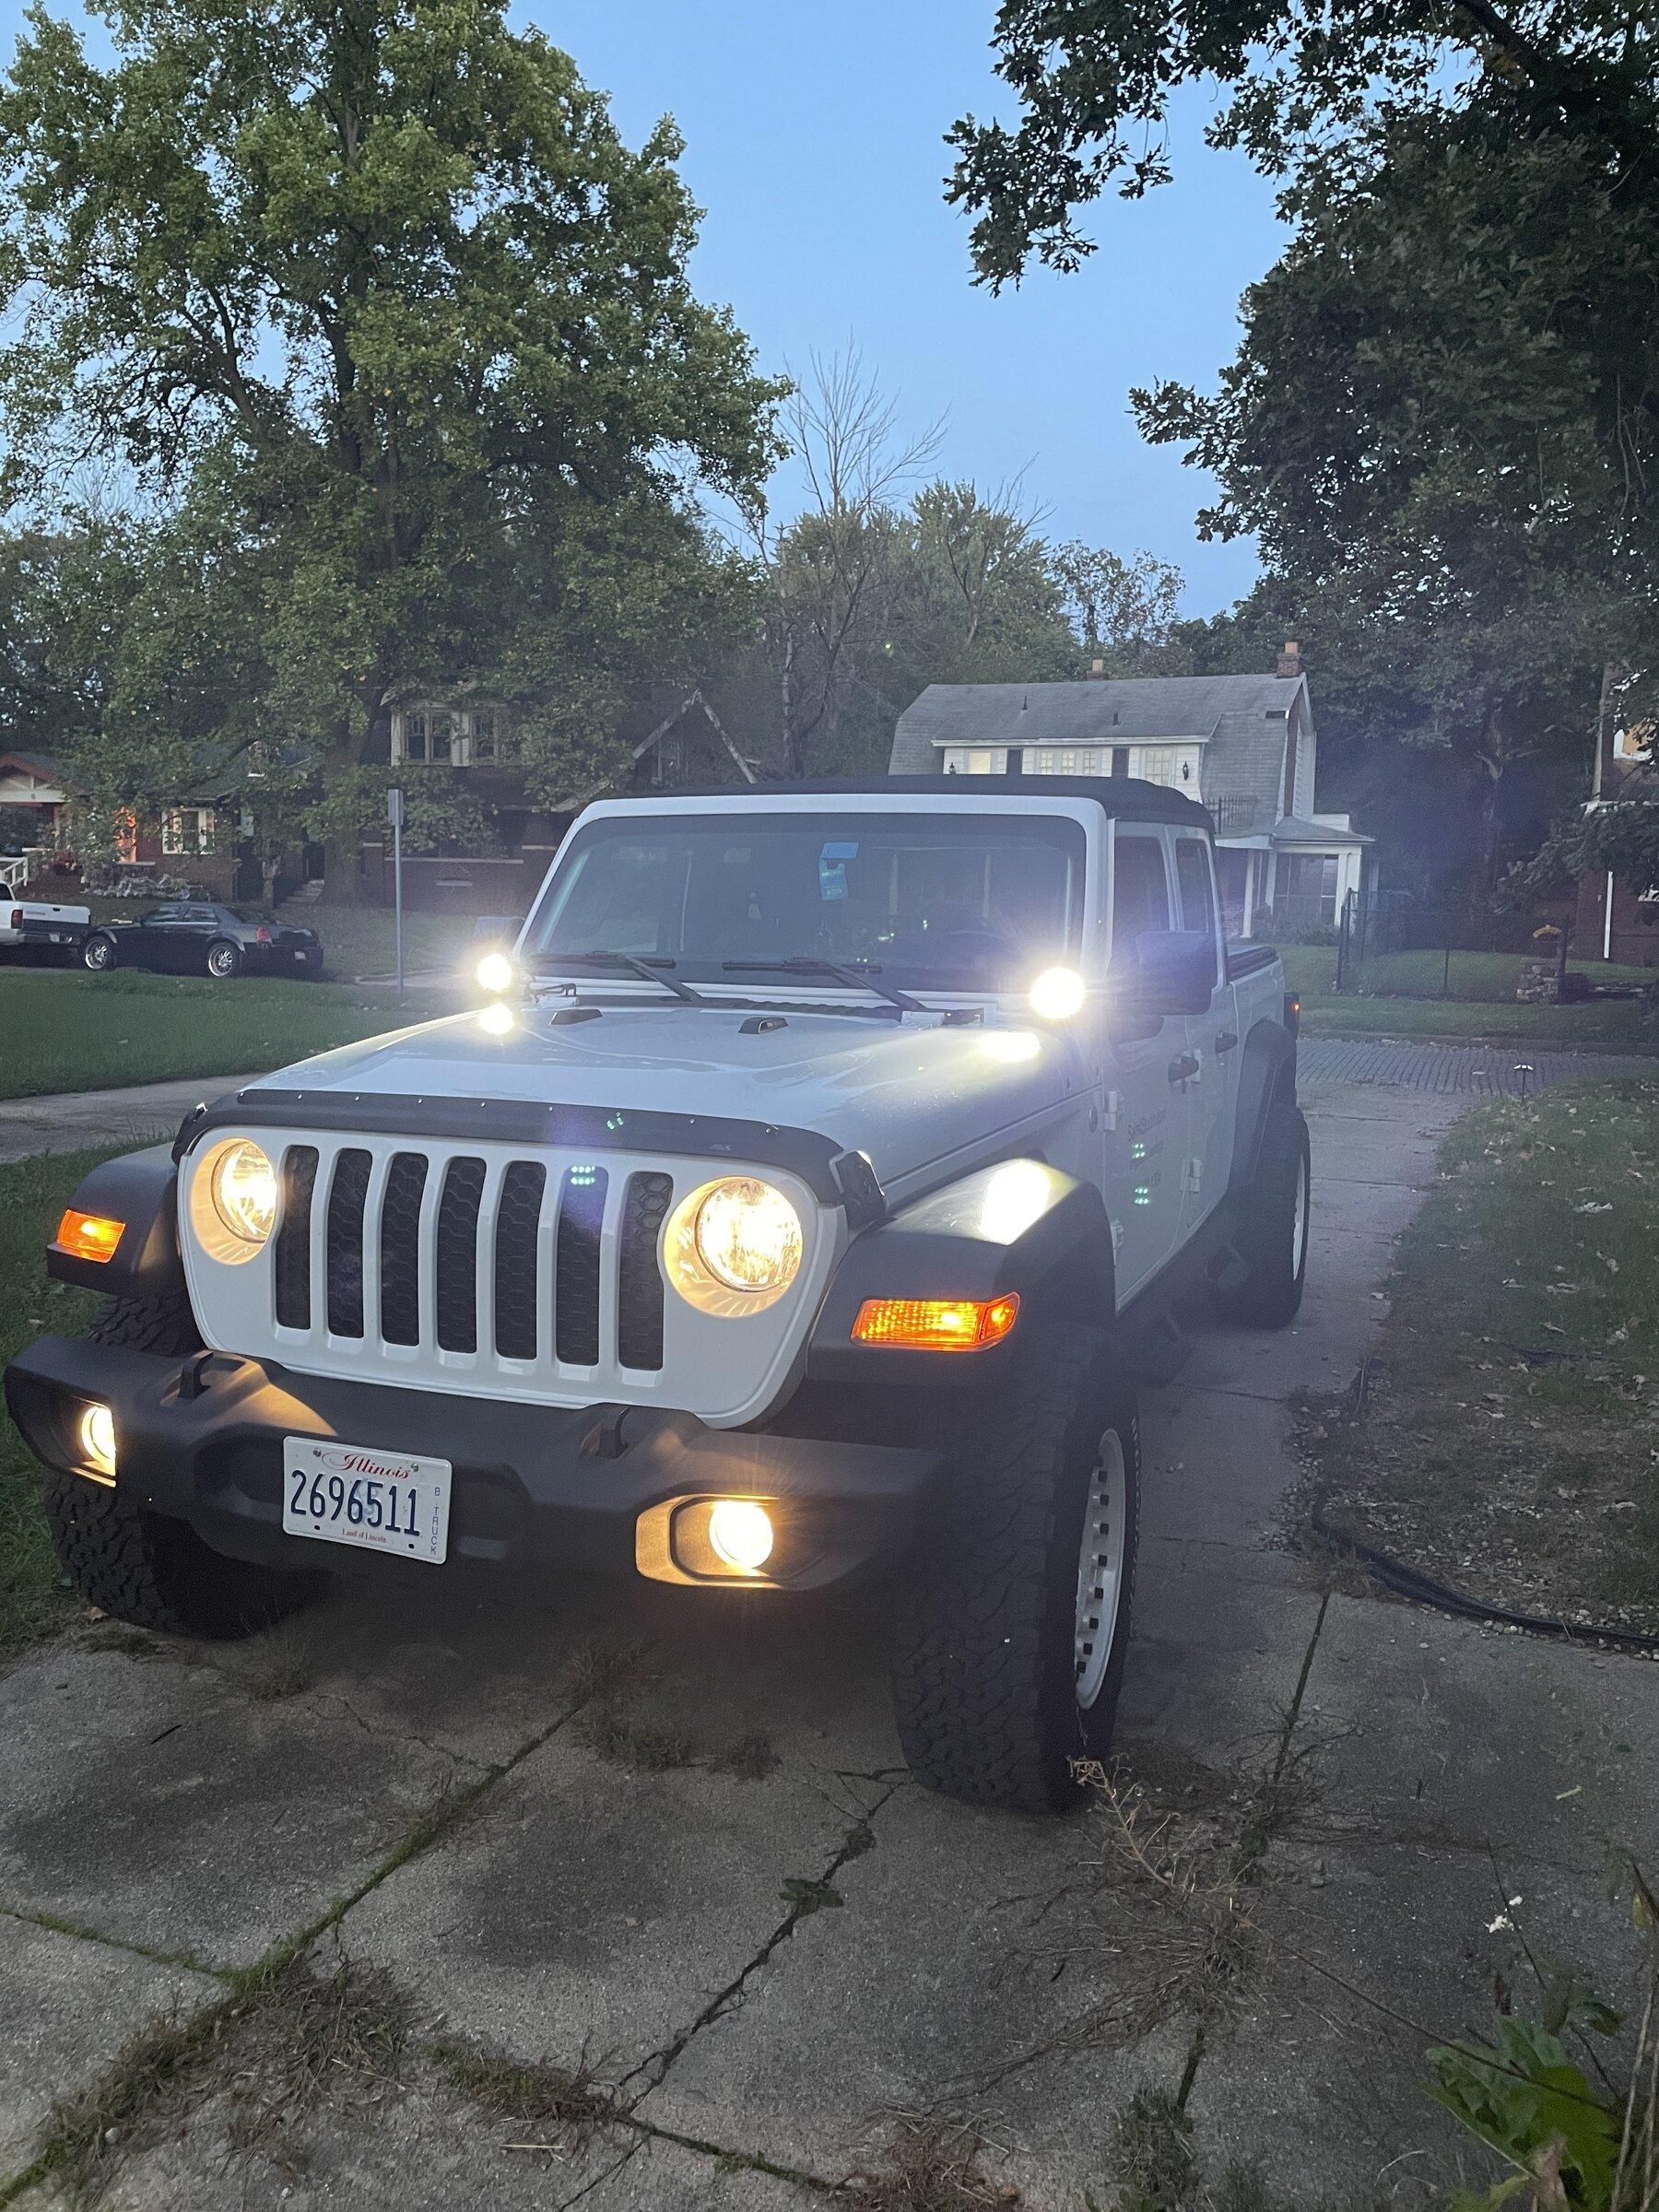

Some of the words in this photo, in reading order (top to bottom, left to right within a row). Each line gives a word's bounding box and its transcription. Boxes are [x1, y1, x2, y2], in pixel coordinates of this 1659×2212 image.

[322, 1452, 411, 1479] Illinois
[290, 1469, 420, 1537] 2696511
[430, 1506, 440, 1556] TRUCK
